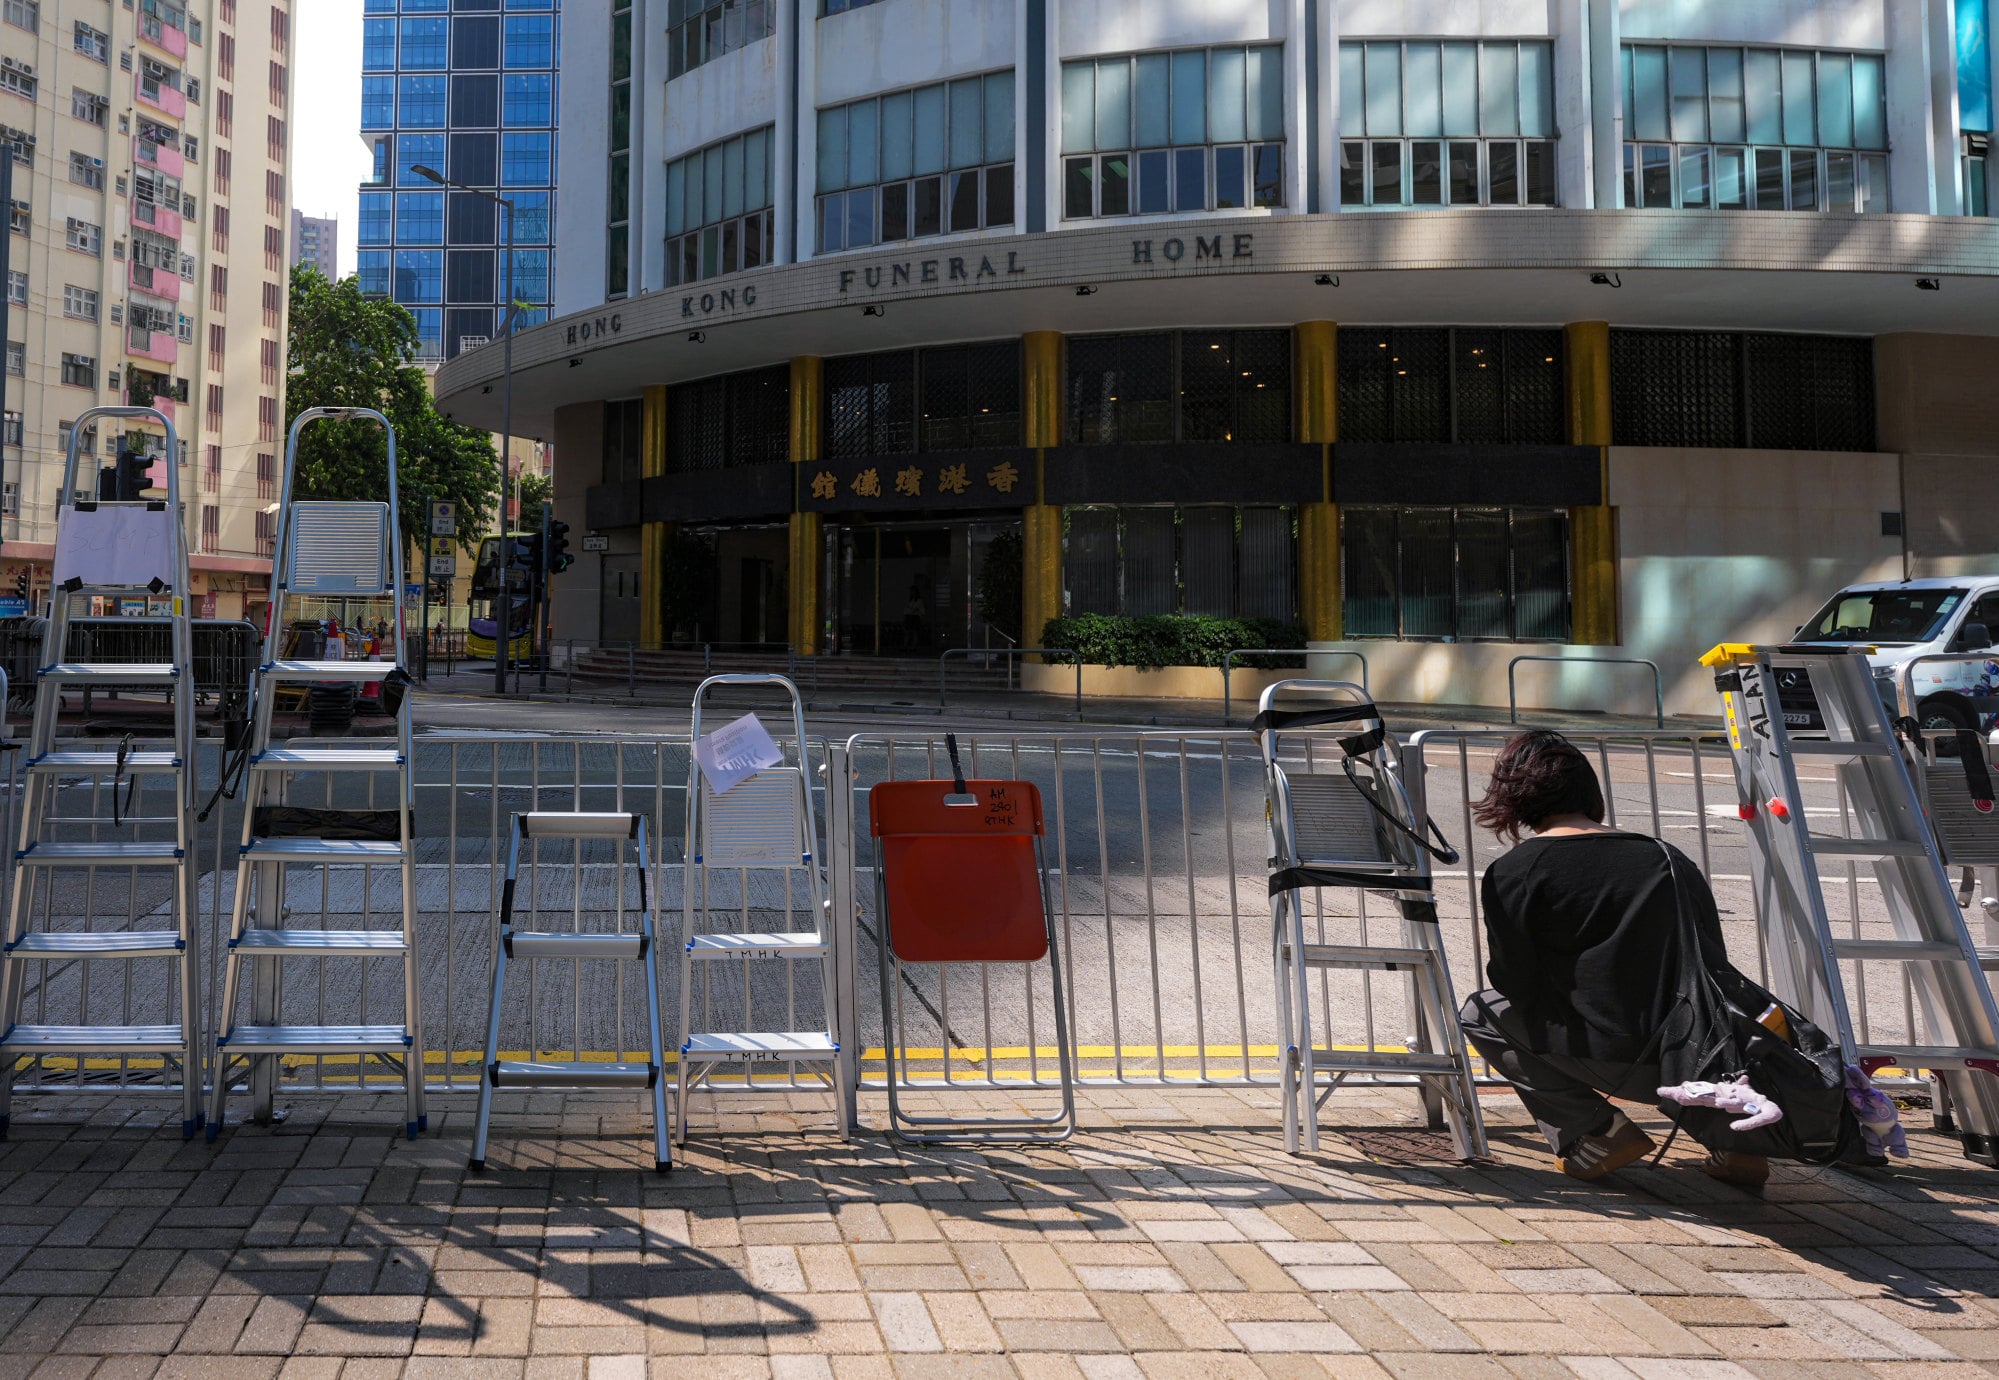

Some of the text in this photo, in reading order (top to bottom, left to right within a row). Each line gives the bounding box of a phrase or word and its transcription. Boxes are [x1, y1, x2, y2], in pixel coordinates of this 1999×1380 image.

[567, 233, 1254, 345] HONG KONG FUNERAL HOME
[1738, 664, 1771, 740] ALAN
[990, 788, 1007, 799] AM
[725, 950, 783, 959] TMHK
[726, 1052, 781, 1061] TMHK
